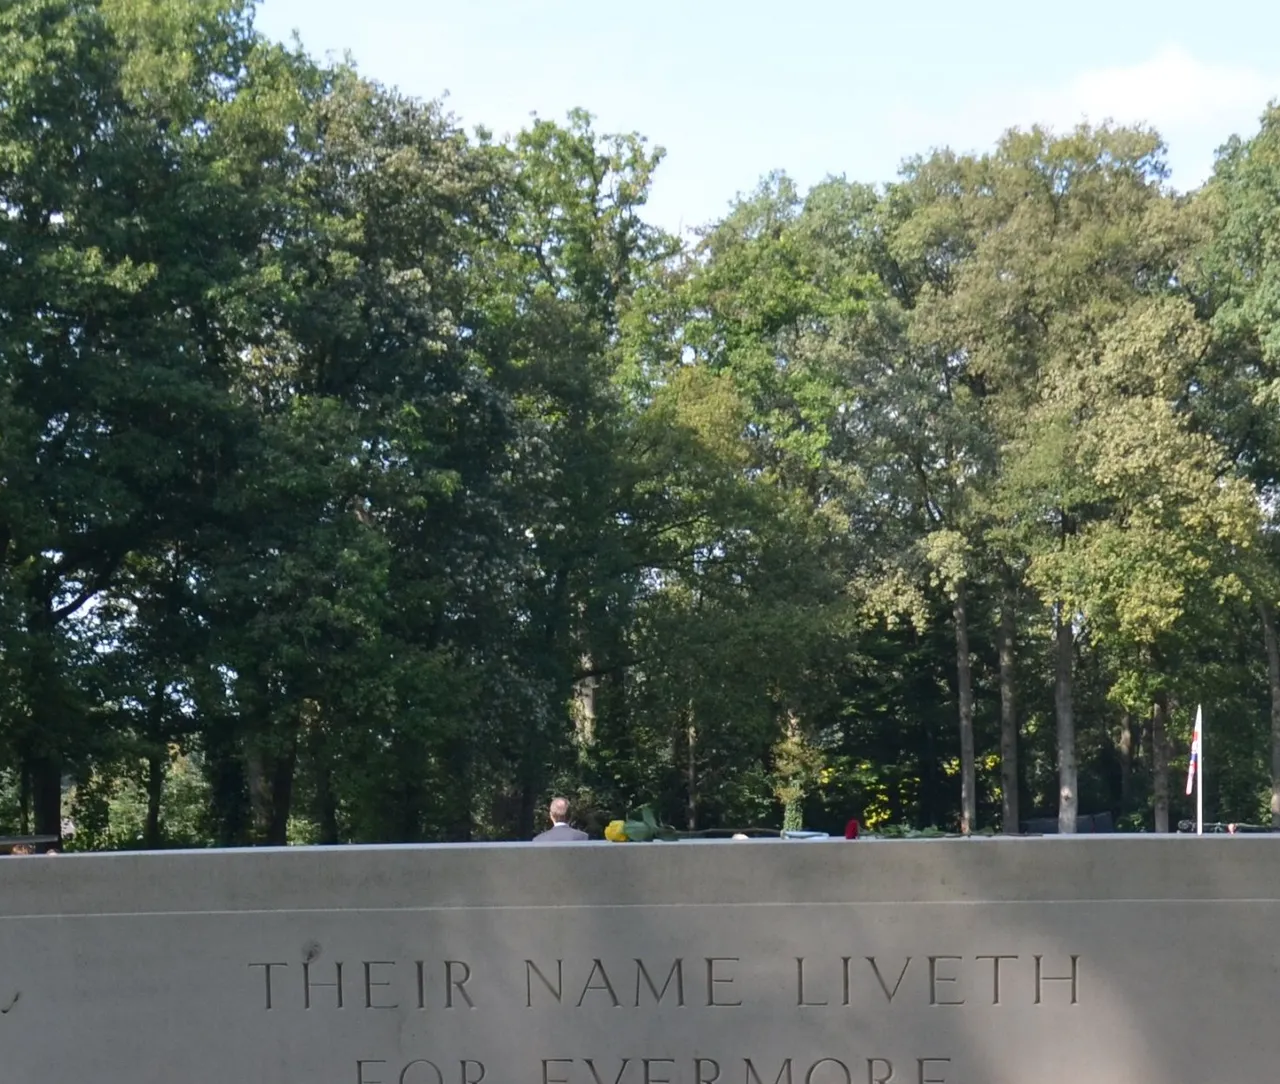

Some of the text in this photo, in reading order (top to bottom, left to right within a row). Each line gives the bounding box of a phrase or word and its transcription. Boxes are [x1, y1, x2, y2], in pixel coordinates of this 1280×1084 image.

[248, 953, 1082, 1011] THEIR NAME LIVETH
